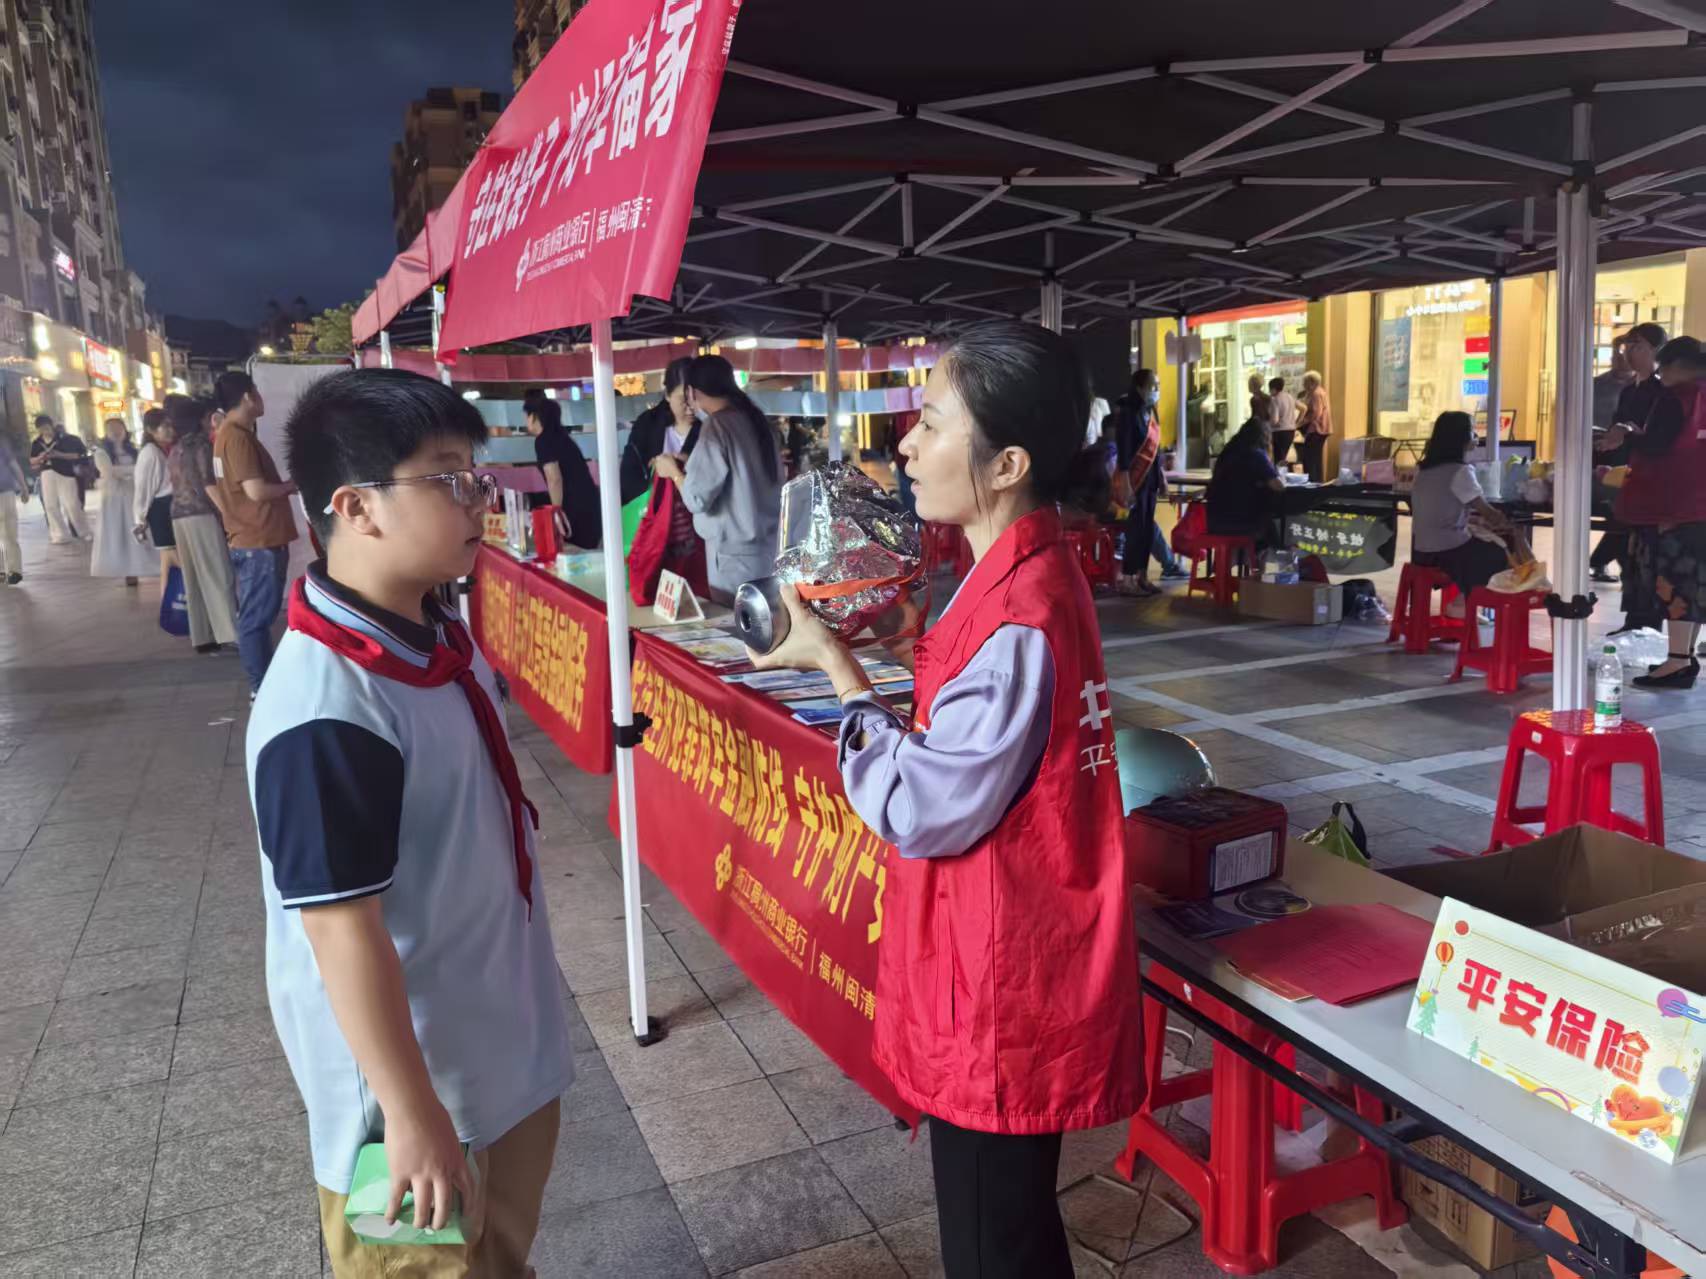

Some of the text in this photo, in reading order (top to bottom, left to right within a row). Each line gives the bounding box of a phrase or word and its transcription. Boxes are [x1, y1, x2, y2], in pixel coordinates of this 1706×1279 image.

[1080, 742, 1118, 777] 平
[818, 951, 876, 1022] 福州闽清
[1457, 958, 1651, 1086] 平安保险
